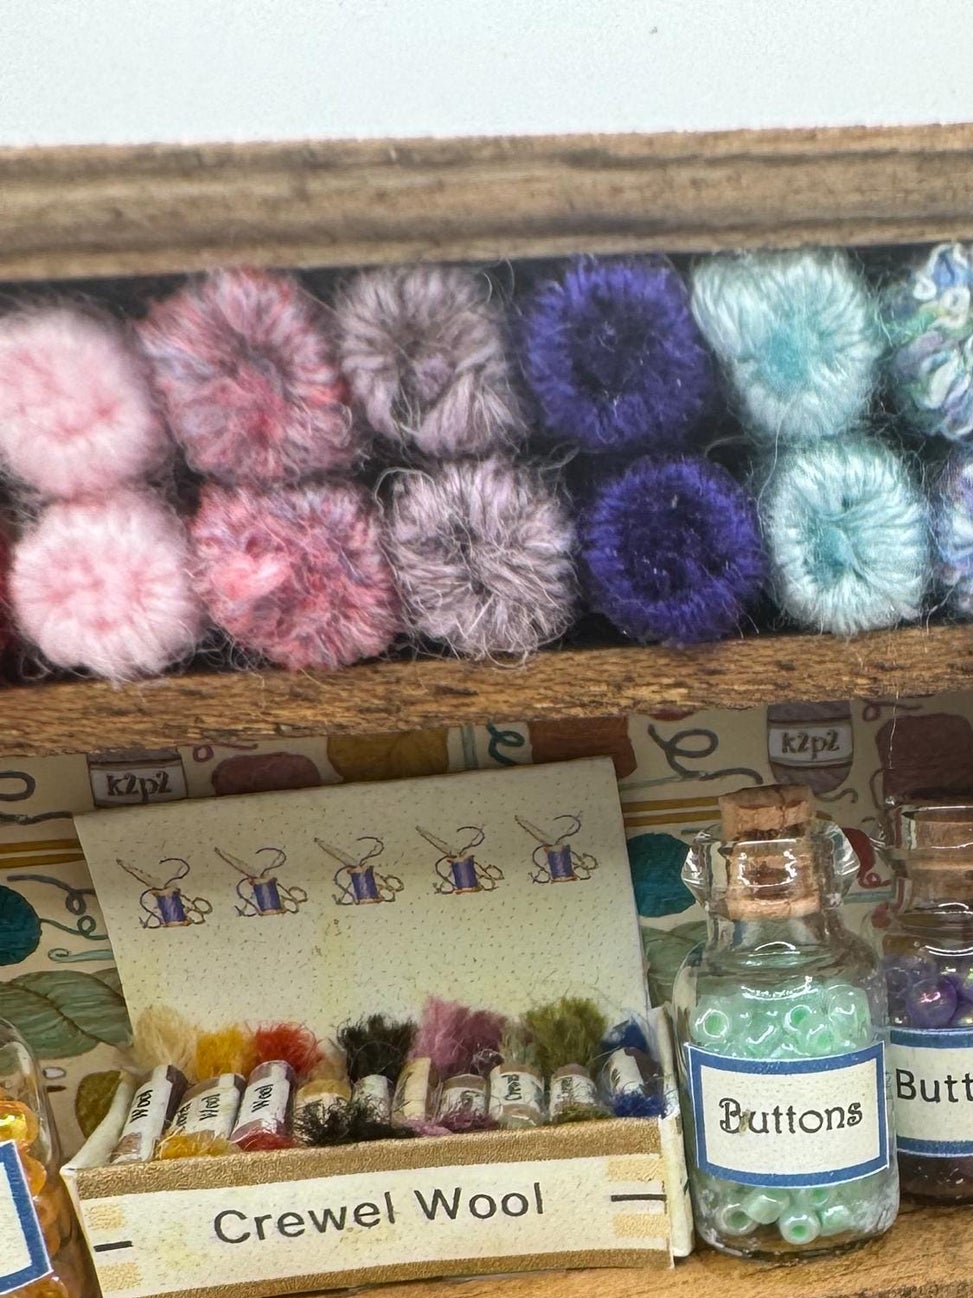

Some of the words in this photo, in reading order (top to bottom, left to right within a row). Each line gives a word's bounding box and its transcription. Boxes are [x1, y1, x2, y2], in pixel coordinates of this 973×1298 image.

[718, 1096, 864, 1135] Buttons
[213, 1190, 396, 1245] Crewel
[413, 1181, 545, 1221] Wool
